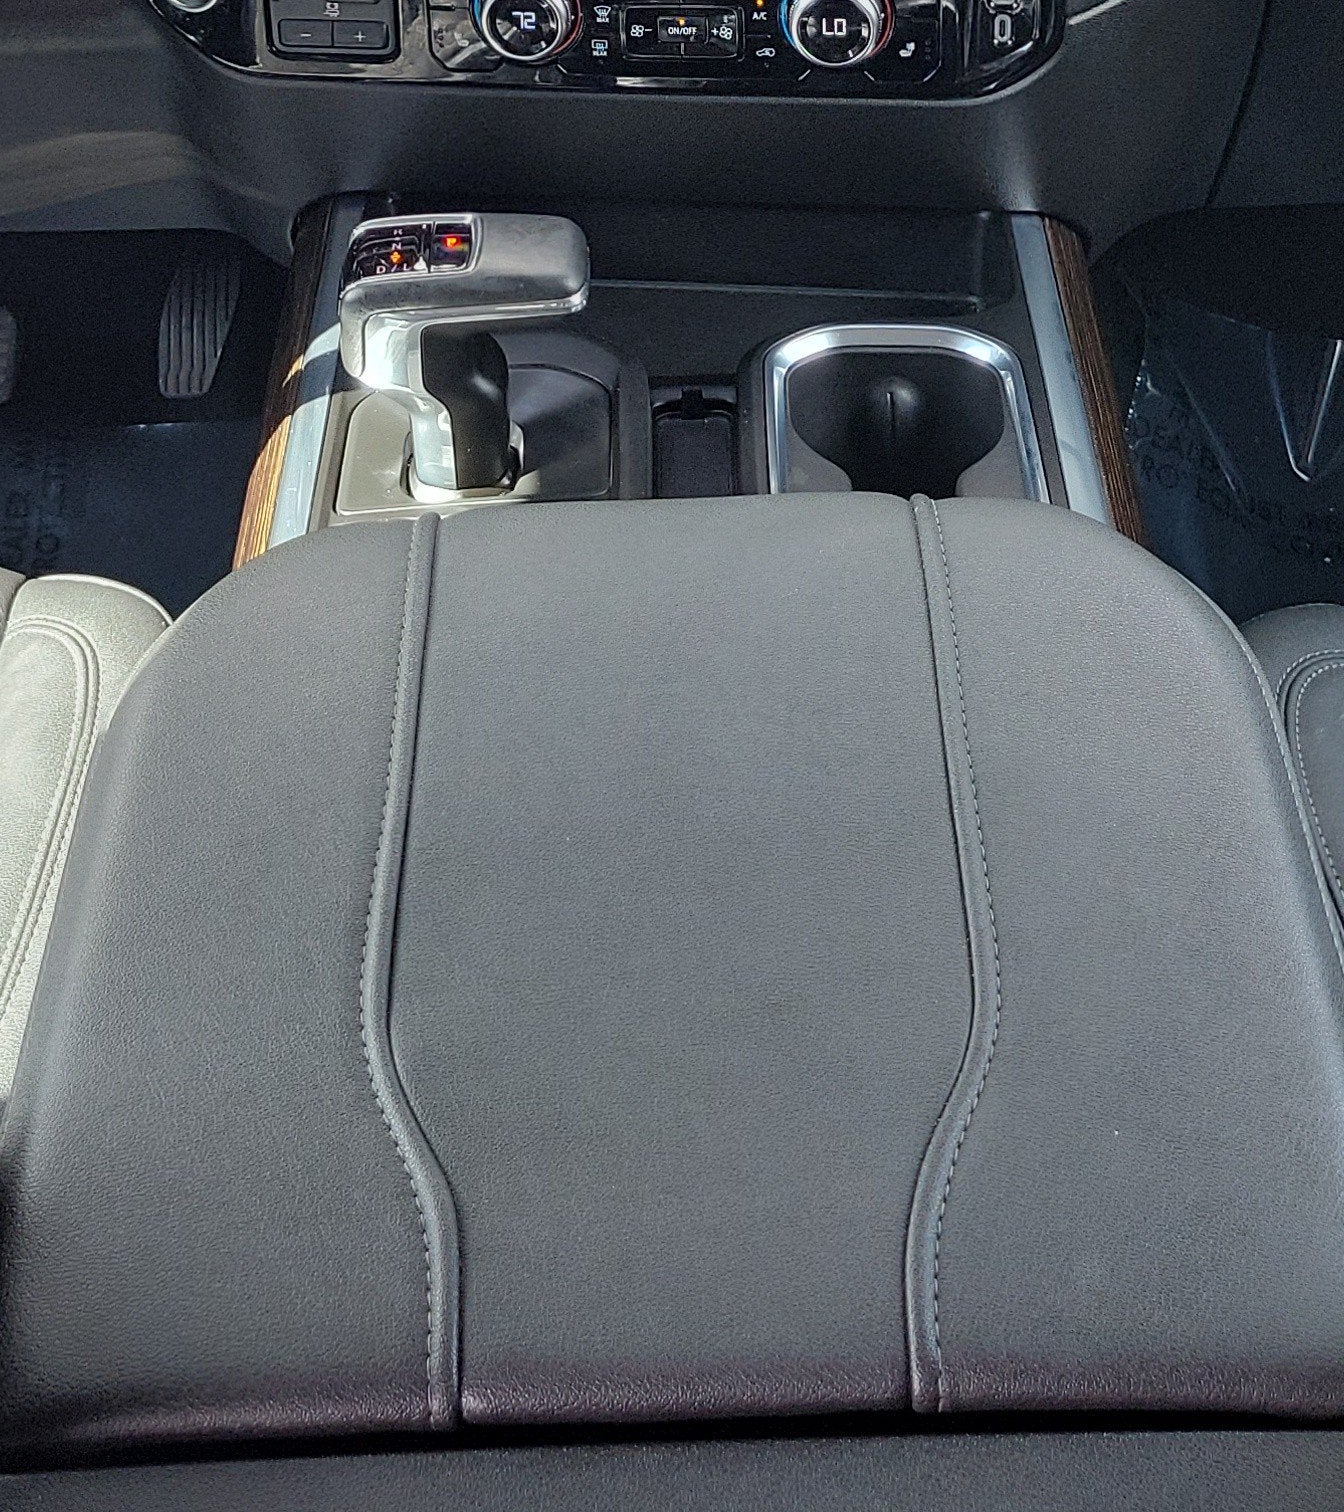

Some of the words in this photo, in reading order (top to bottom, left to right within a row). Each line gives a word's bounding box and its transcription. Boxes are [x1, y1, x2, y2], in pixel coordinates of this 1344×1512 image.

[511, 11, 537, 30] 72
[752, 11, 767, 21] A/C
[668, 26, 698, 36] ON/OFF
